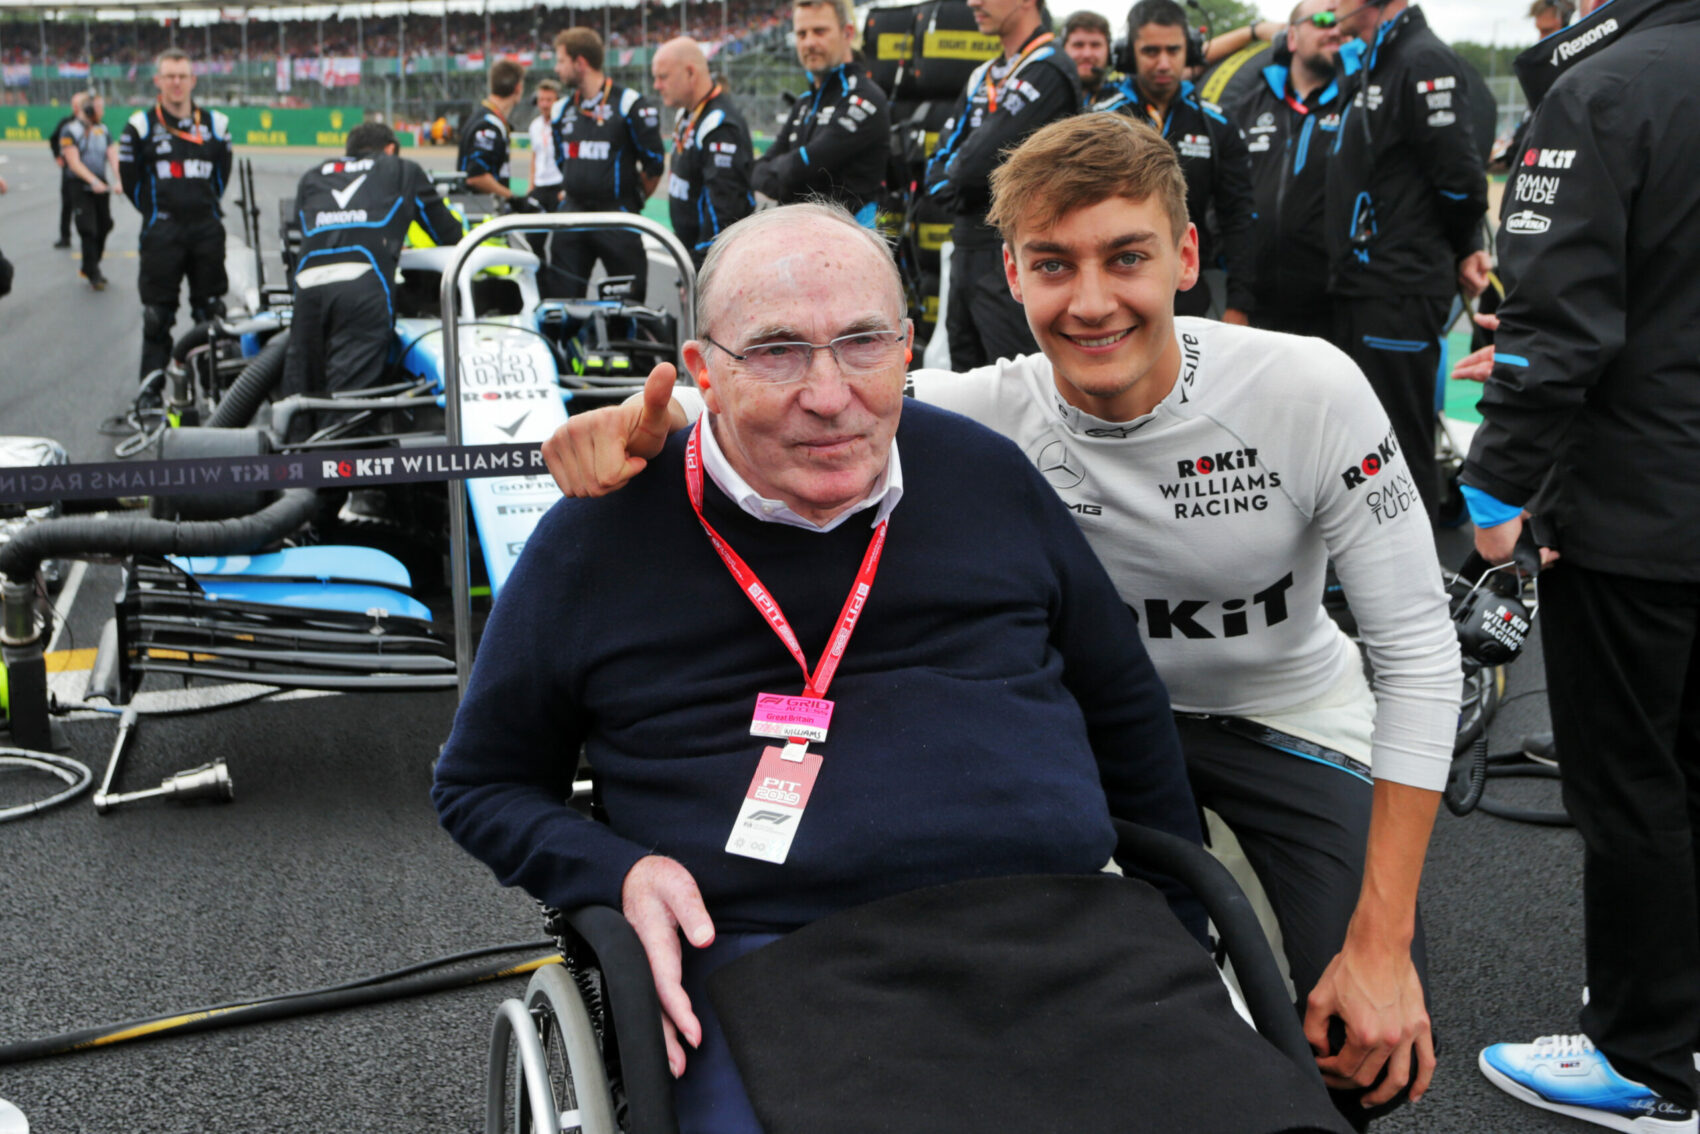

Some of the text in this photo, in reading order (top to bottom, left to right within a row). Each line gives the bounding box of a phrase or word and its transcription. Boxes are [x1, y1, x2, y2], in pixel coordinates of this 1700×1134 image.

[1557, 18, 1619, 61] Rexona
[1521, 148, 1577, 169] OKiT
[1182, 333, 1201, 387] sure
[322, 457, 394, 479] ROKiT
[401, 450, 525, 473] WILLIAMS
[1177, 448, 1258, 479] ROKiT
[498, 481, 557, 491] SOFIN
[1158, 472, 1282, 499] WILLIAMS
[1175, 494, 1268, 519] RACING
[758, 593, 783, 623] PIT
[844, 595, 865, 626] PIT
[1481, 621, 1518, 651] RACING
[787, 698, 830, 710] GRID
[766, 713, 815, 723] Great Britain
[755, 786, 801, 806] 2019
[762, 777, 802, 792] PIT
